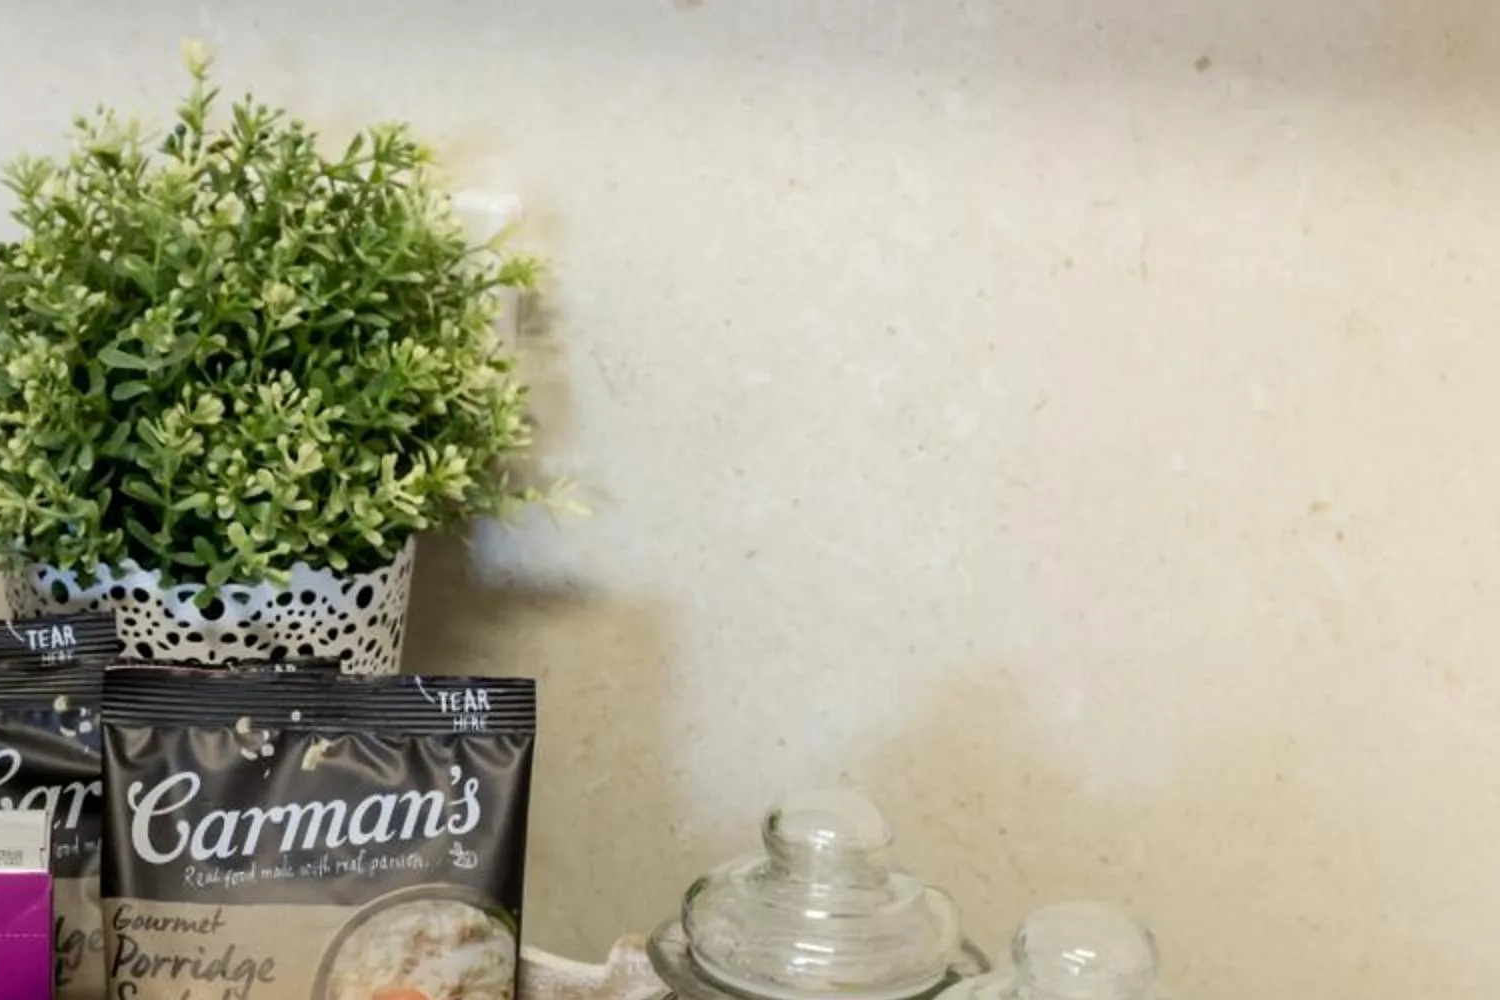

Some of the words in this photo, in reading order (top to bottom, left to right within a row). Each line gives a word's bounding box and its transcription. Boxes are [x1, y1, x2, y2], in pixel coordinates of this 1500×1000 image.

[25, 623, 77, 651] TEAR
[436, 687, 492, 714] TEAR
[453, 713, 488, 733] HERE
[127, 766, 481, 865] Carman's
[112, 903, 227, 936] Gourmet
